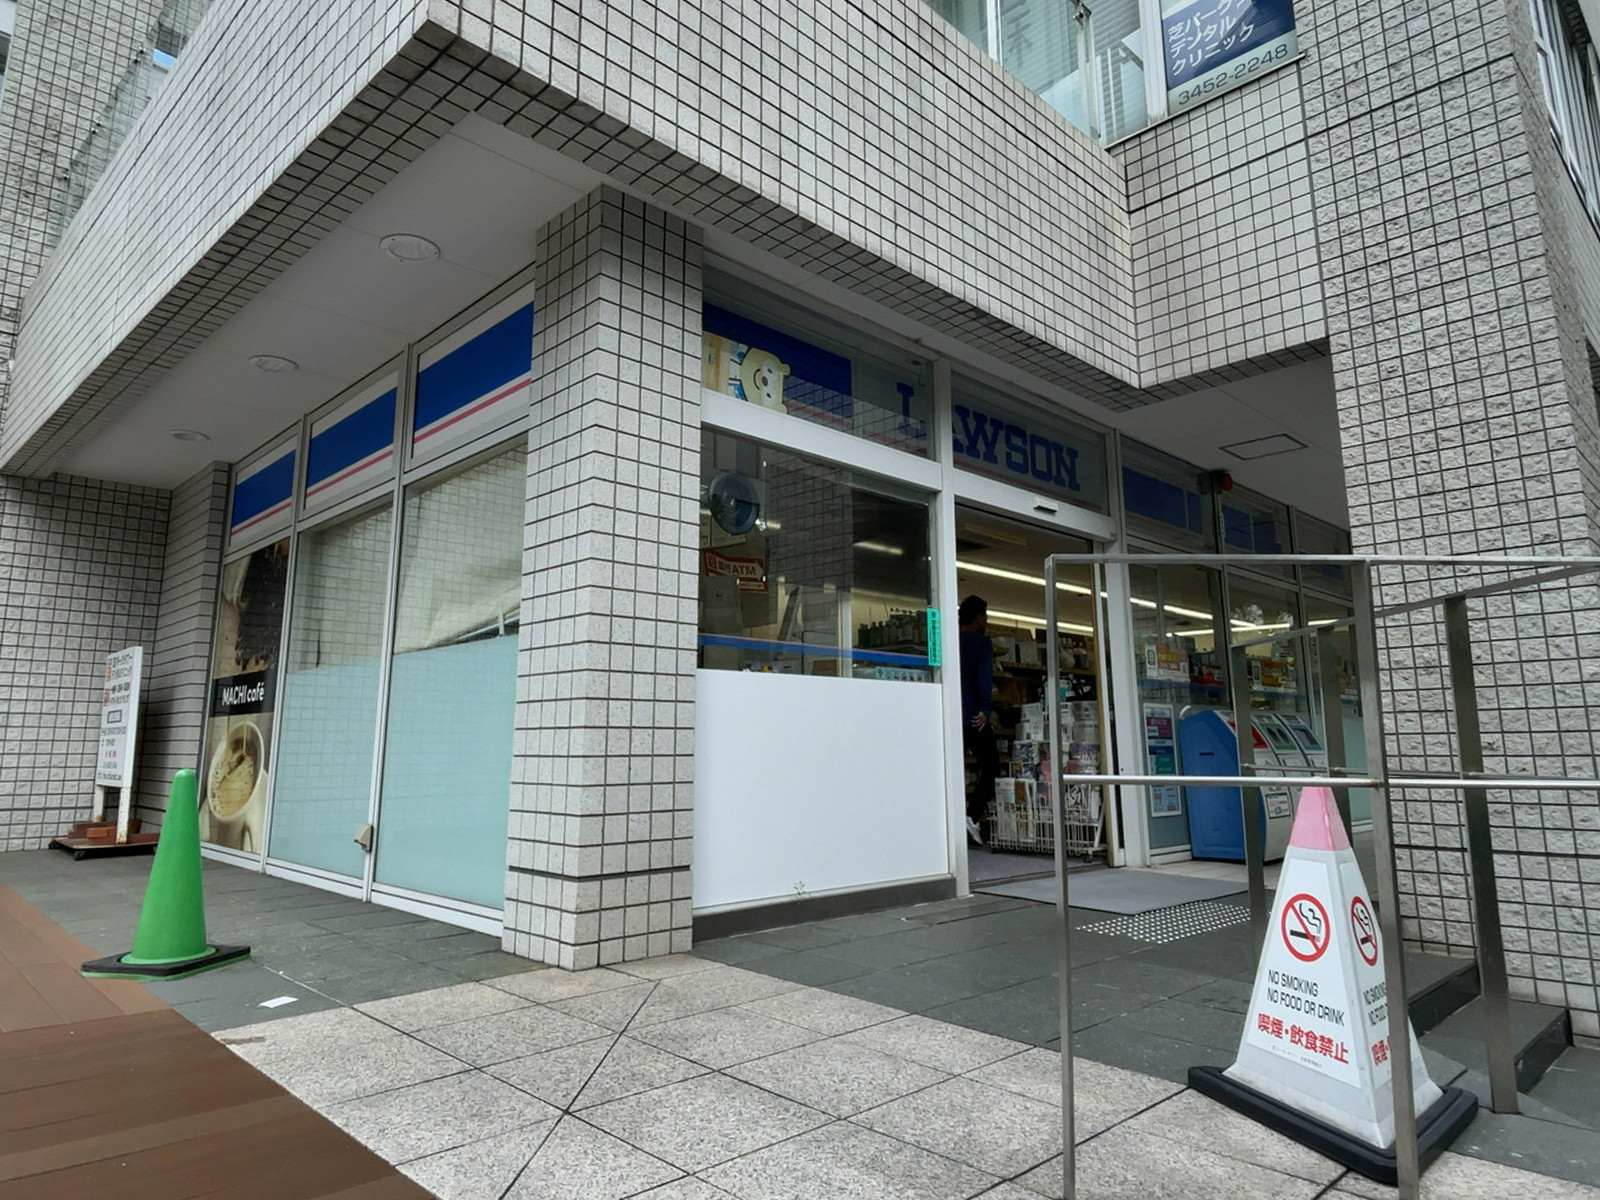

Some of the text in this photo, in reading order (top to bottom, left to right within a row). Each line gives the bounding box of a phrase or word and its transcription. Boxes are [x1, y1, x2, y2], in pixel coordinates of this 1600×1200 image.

[1170, 16, 1236, 58] デンタル
[1172, 22, 1254, 76] クリニック
[1178, 43, 1288, 105] 3452-2248
[222, 681, 265, 706] MACHI café
[1268, 969, 1318, 997] NO SMOKING
[1267, 987, 1345, 1026] NO FOOD OR DRINK
[1258, 1012, 1349, 1064] 喫煙・飲食禁止
